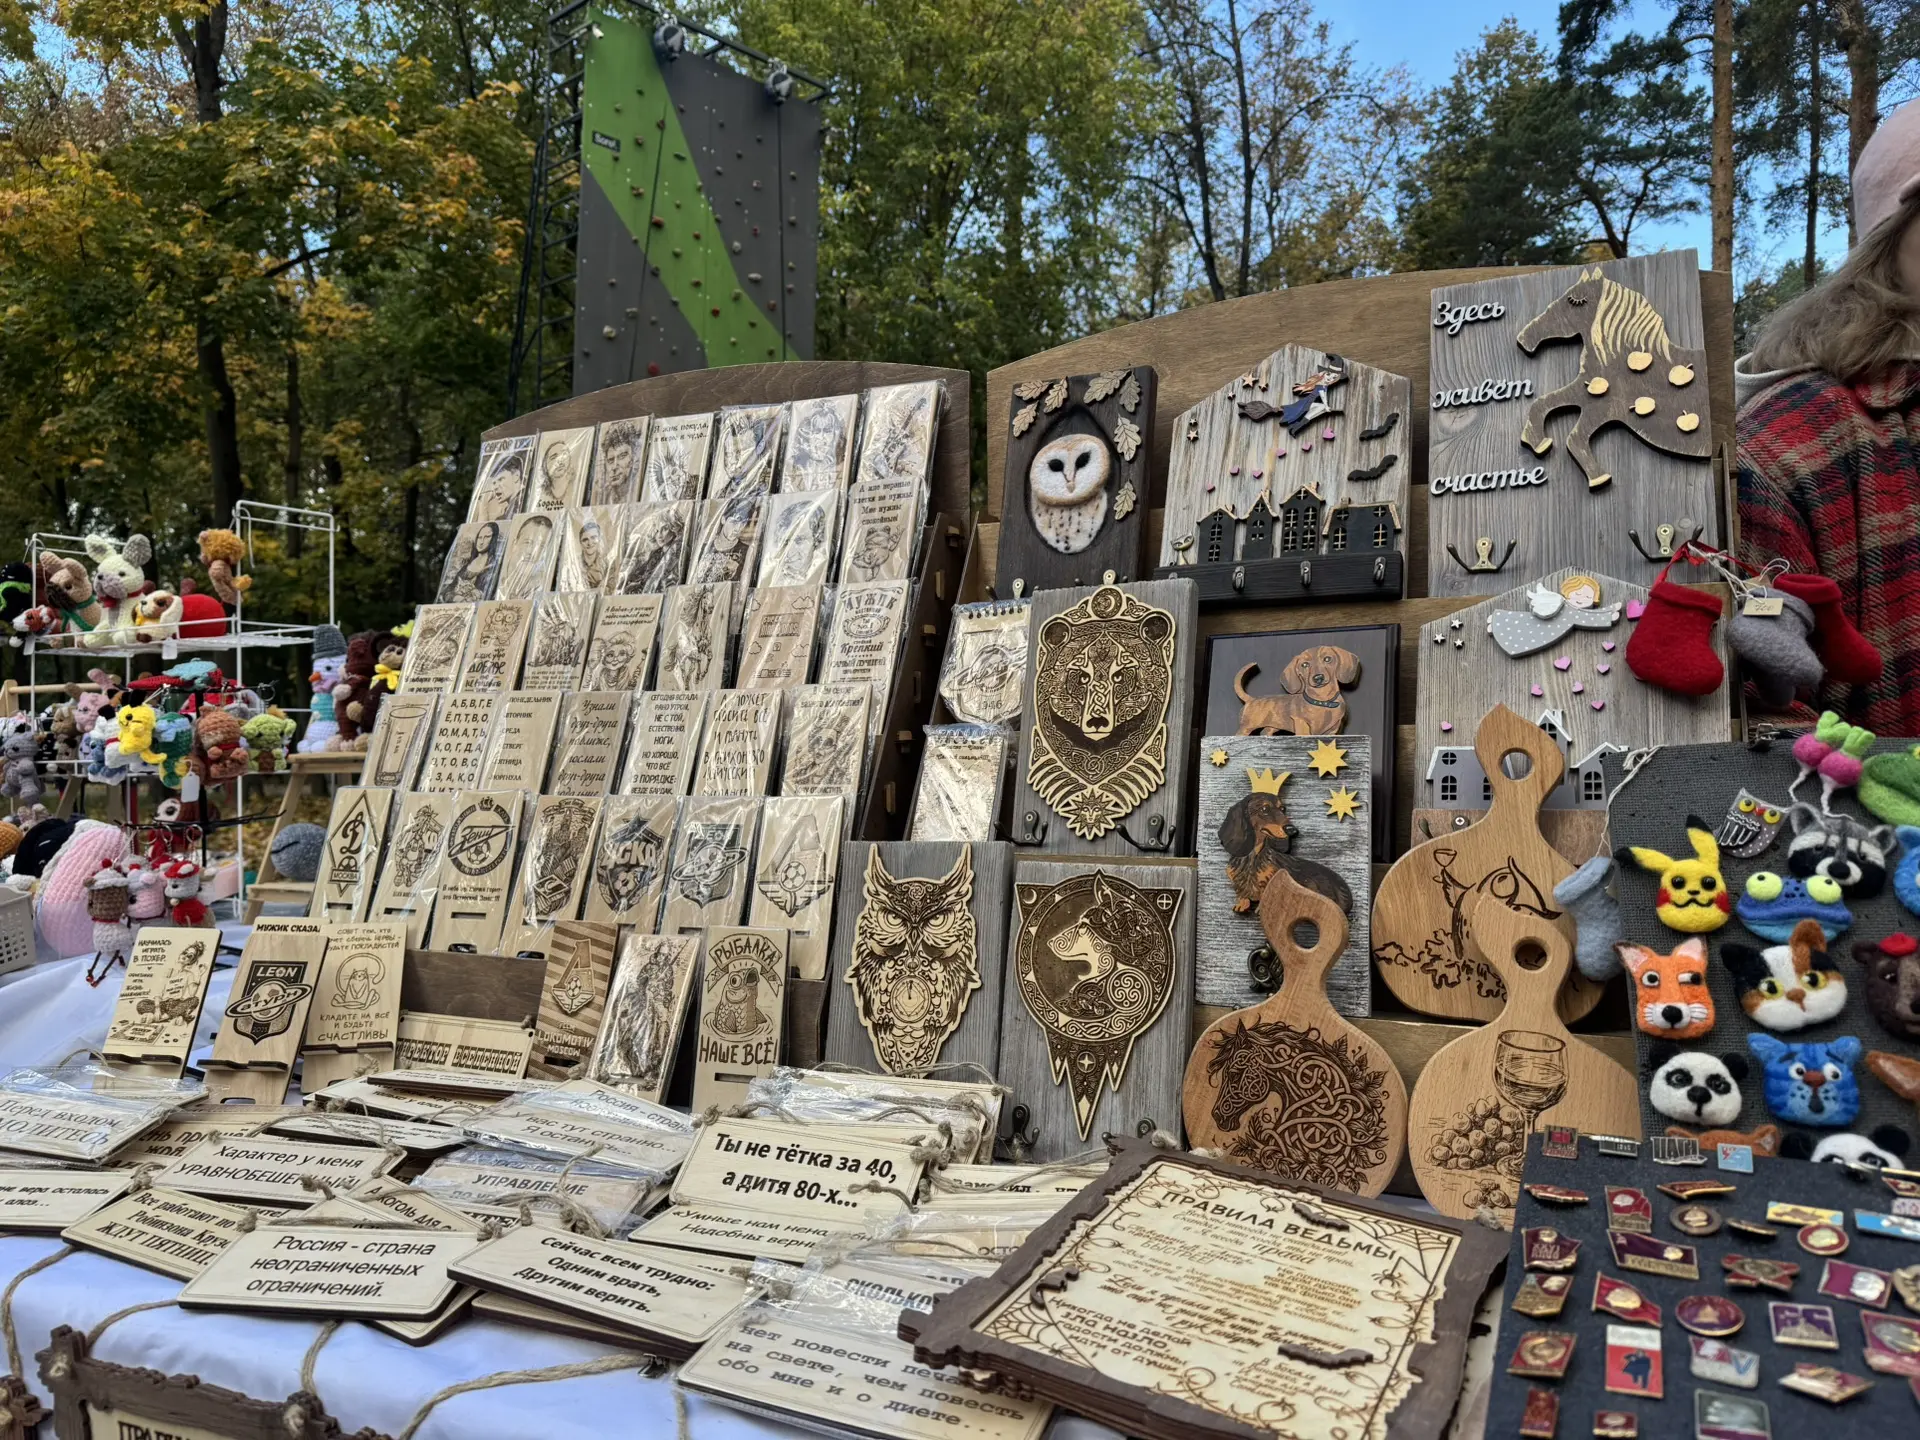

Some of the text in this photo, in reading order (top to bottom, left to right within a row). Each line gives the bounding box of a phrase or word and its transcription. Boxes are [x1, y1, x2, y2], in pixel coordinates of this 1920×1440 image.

[1433, 301, 1505, 335] Здесь
[1432, 377, 1533, 409] живёт
[1430, 465, 1547, 496] счастье
[840, 641, 885, 656] Крепкий
[583, 700, 616, 716] Узнали
[571, 717, 618, 733] друг-друга
[256, 924, 289, 932] МУЖИК
[714, 936, 778, 966] РЫБАЛКА
[257, 967, 298, 977] LEON
[320, 1013, 358, 1022] КЛАДИТЕ
[317, 1030, 389, 1041] СЧАСТЛИВЫ
[537, 1029, 595, 1047] LOKOMOTIV
[451, 1045, 523, 1075] ВСЕЛЕННОЙ
[548, 1044, 581, 1057] MOSCOW
[699, 1034, 778, 1066] НАШЕ ВСЁ!
[0, 1099, 122, 1127] Перед входом
[589, 1089, 639, 1112] Россия
[521, 1125, 537, 1133] Я
[526, 1116, 559, 1128] вас
[561, 1122, 591, 1136] тут
[213, 1145, 364, 1168] Характер у меня
[714, 1133, 899, 1183] Ты не тётка за 40,
[18, 1186, 110, 1195] вера осталась
[722, 1170, 859, 1210] а дитя 80-х...
[133, 1192, 236, 1229] Все работают по
[413, 1213, 442, 1230] ДЛЯ
[96, 1221, 146, 1243] ЖДУТ
[127, 1210, 196, 1237] Робинзона
[680, 1223, 765, 1242] Надобны
[745, 1219, 780, 1231] нам
[1161, 1191, 1397, 1261] ПРАВИЛА ВЕДЬМЫ
[273, 1235, 347, 1252] Россия
[362, 1242, 436, 1256] страна
[1252, 1243, 1316, 1265] права
[250, 1258, 424, 1277] неограниченных
[540, 1236, 717, 1293] Сейчас всем трудно:
[547, 1256, 662, 1298] Одним врать,
[246, 1278, 383, 1297] ограничений.
[513, 1266, 652, 1313] Другим верить.
[1048, 1296, 1193, 1347] Никогда не делай
[1060, 1311, 1172, 1353] зла назло,
[738, 1324, 891, 1370] нет повести
[1056, 1320, 1188, 1367] гадости должны
[1067, 1334, 1179, 1373] идти от души
[717, 1356, 760, 1375] обо
[770, 1371, 815, 1390] мне
[827, 1385, 845, 1397] и
[856, 1391, 872, 1404] о
[724, 1339, 754, 1354] на
[765, 1349, 845, 1379] свете,
[863, 1373, 907, 1392] чем
[918, 1387, 1025, 1421] повесть
